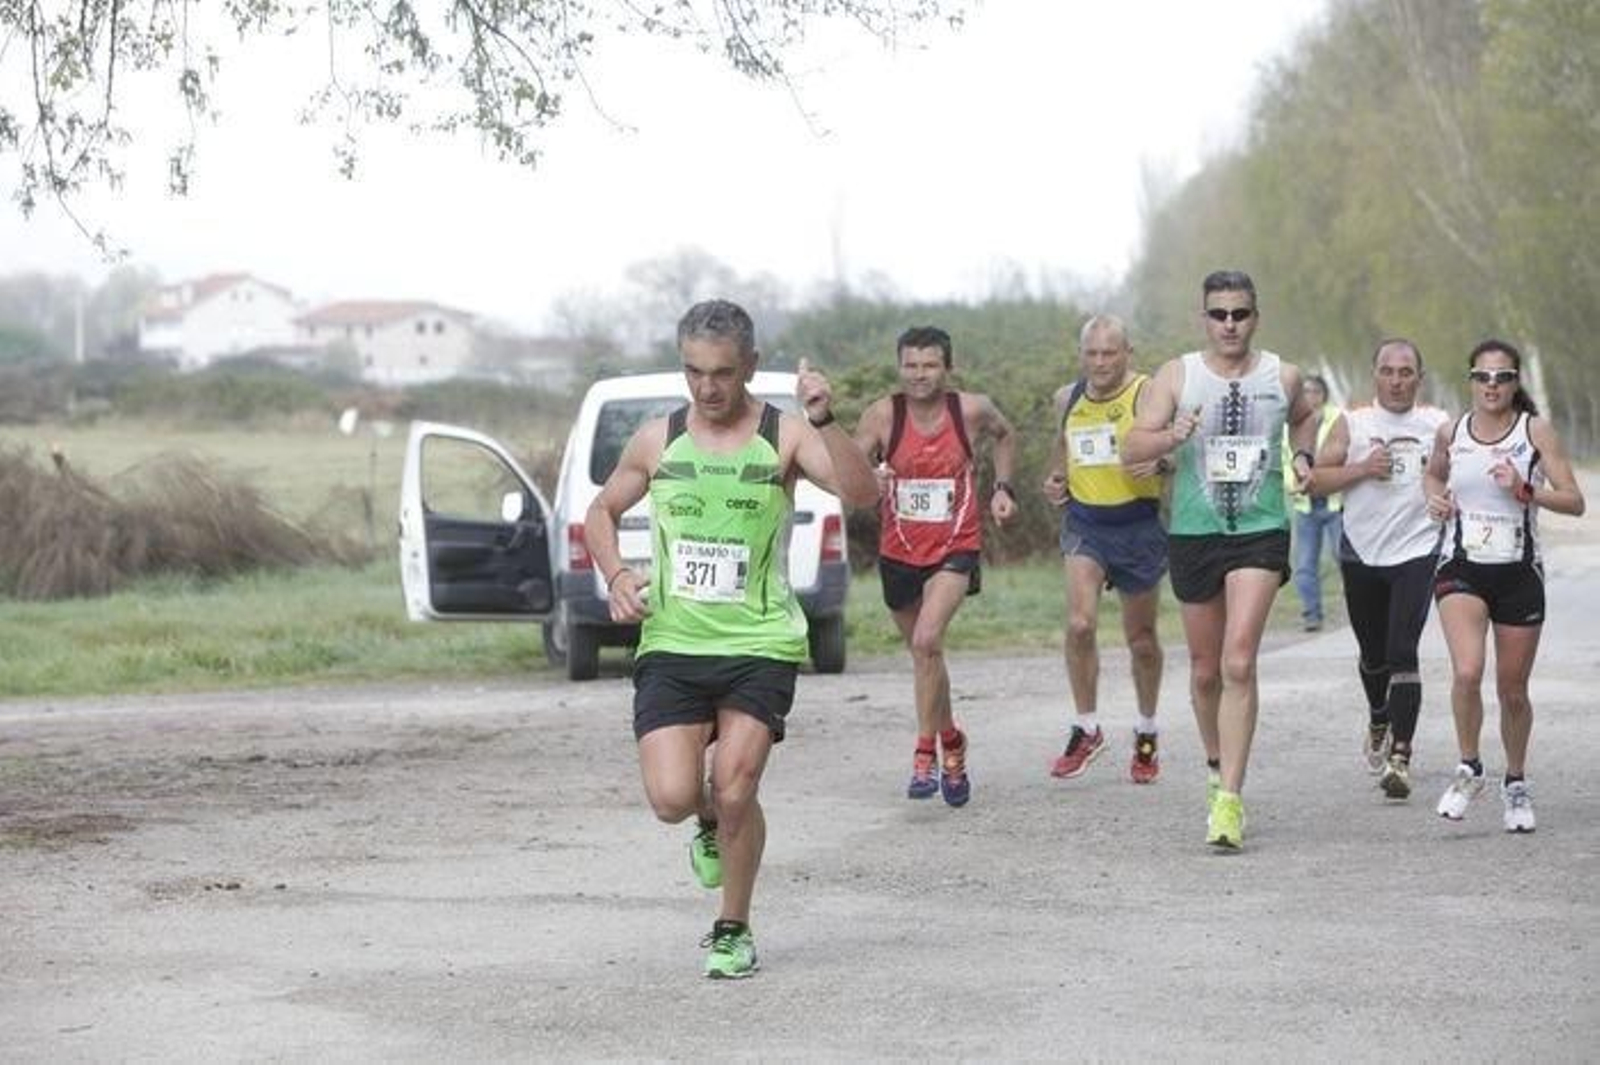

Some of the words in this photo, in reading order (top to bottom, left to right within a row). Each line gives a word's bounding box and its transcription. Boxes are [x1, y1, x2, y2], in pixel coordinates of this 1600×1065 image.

[1226, 450, 1237, 469] 9
[911, 493, 931, 511] 36
[686, 561, 717, 587] 371
